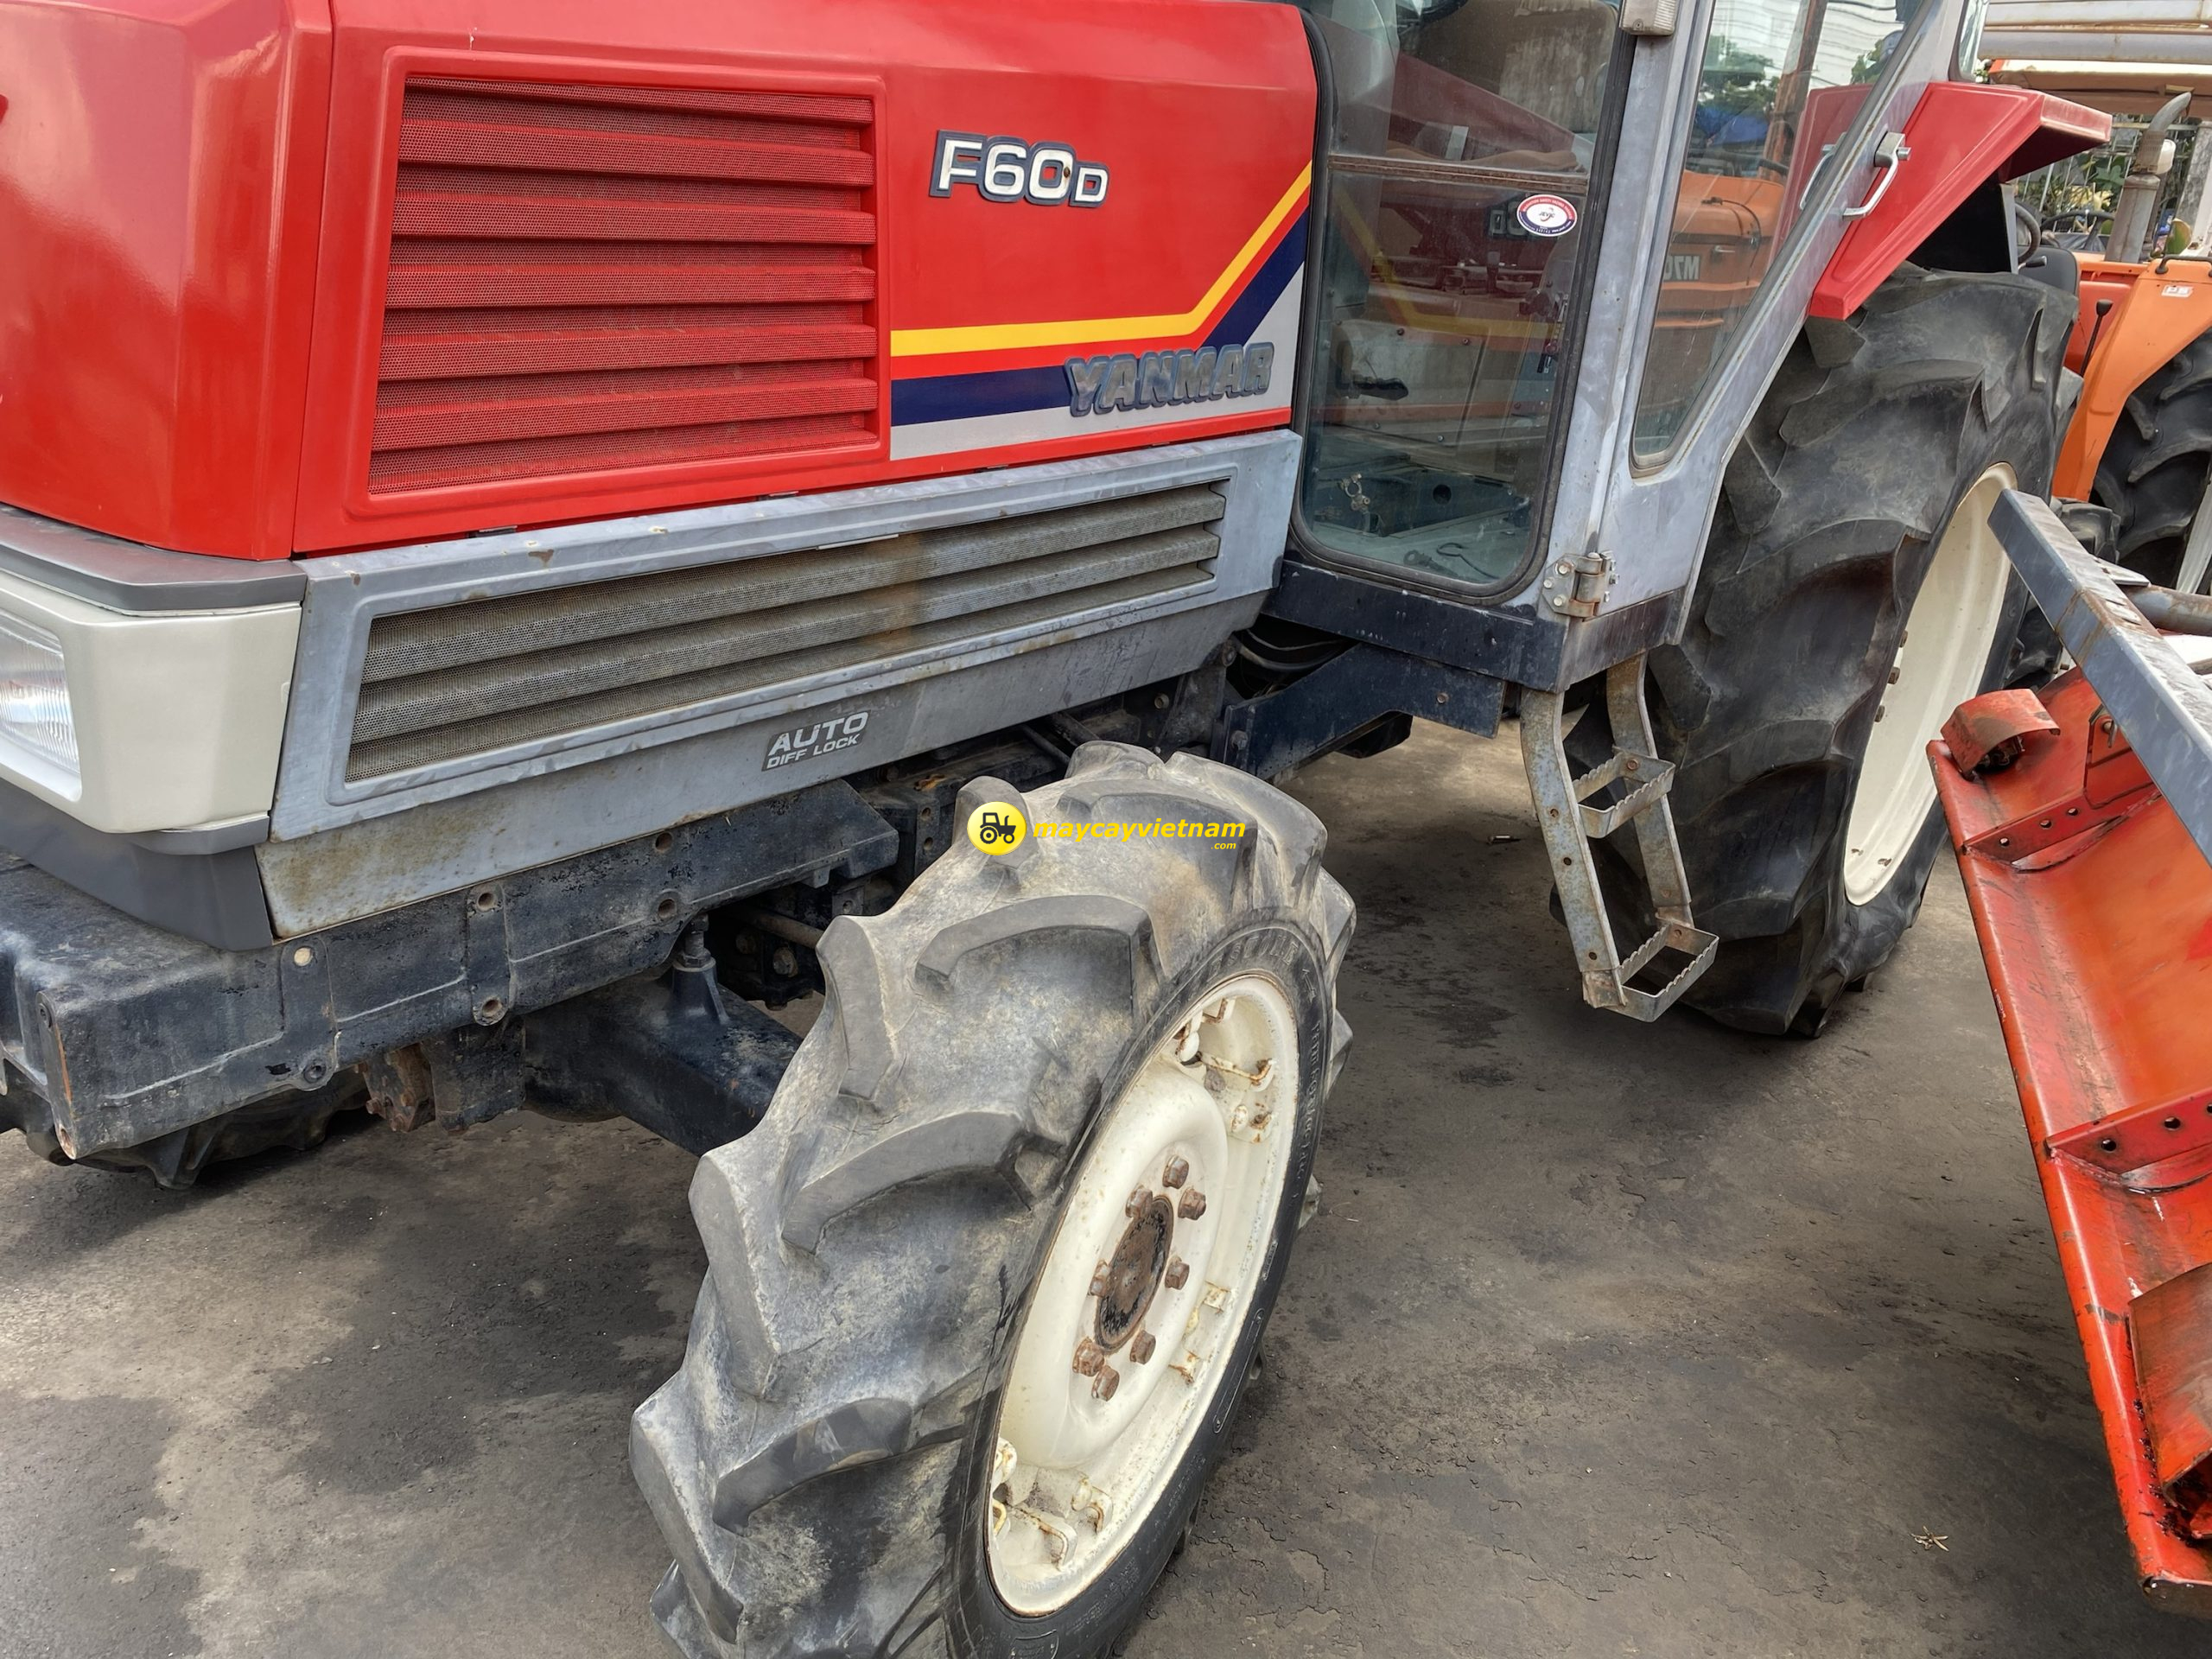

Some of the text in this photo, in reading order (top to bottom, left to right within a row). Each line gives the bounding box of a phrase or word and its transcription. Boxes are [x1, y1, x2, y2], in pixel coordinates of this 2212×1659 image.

[933, 132, 1109, 206] F60D
[1066, 343, 1274, 415] YANMAR
[766, 734, 860, 768] DIFF LOCK
[768, 712, 868, 756] AUTO
